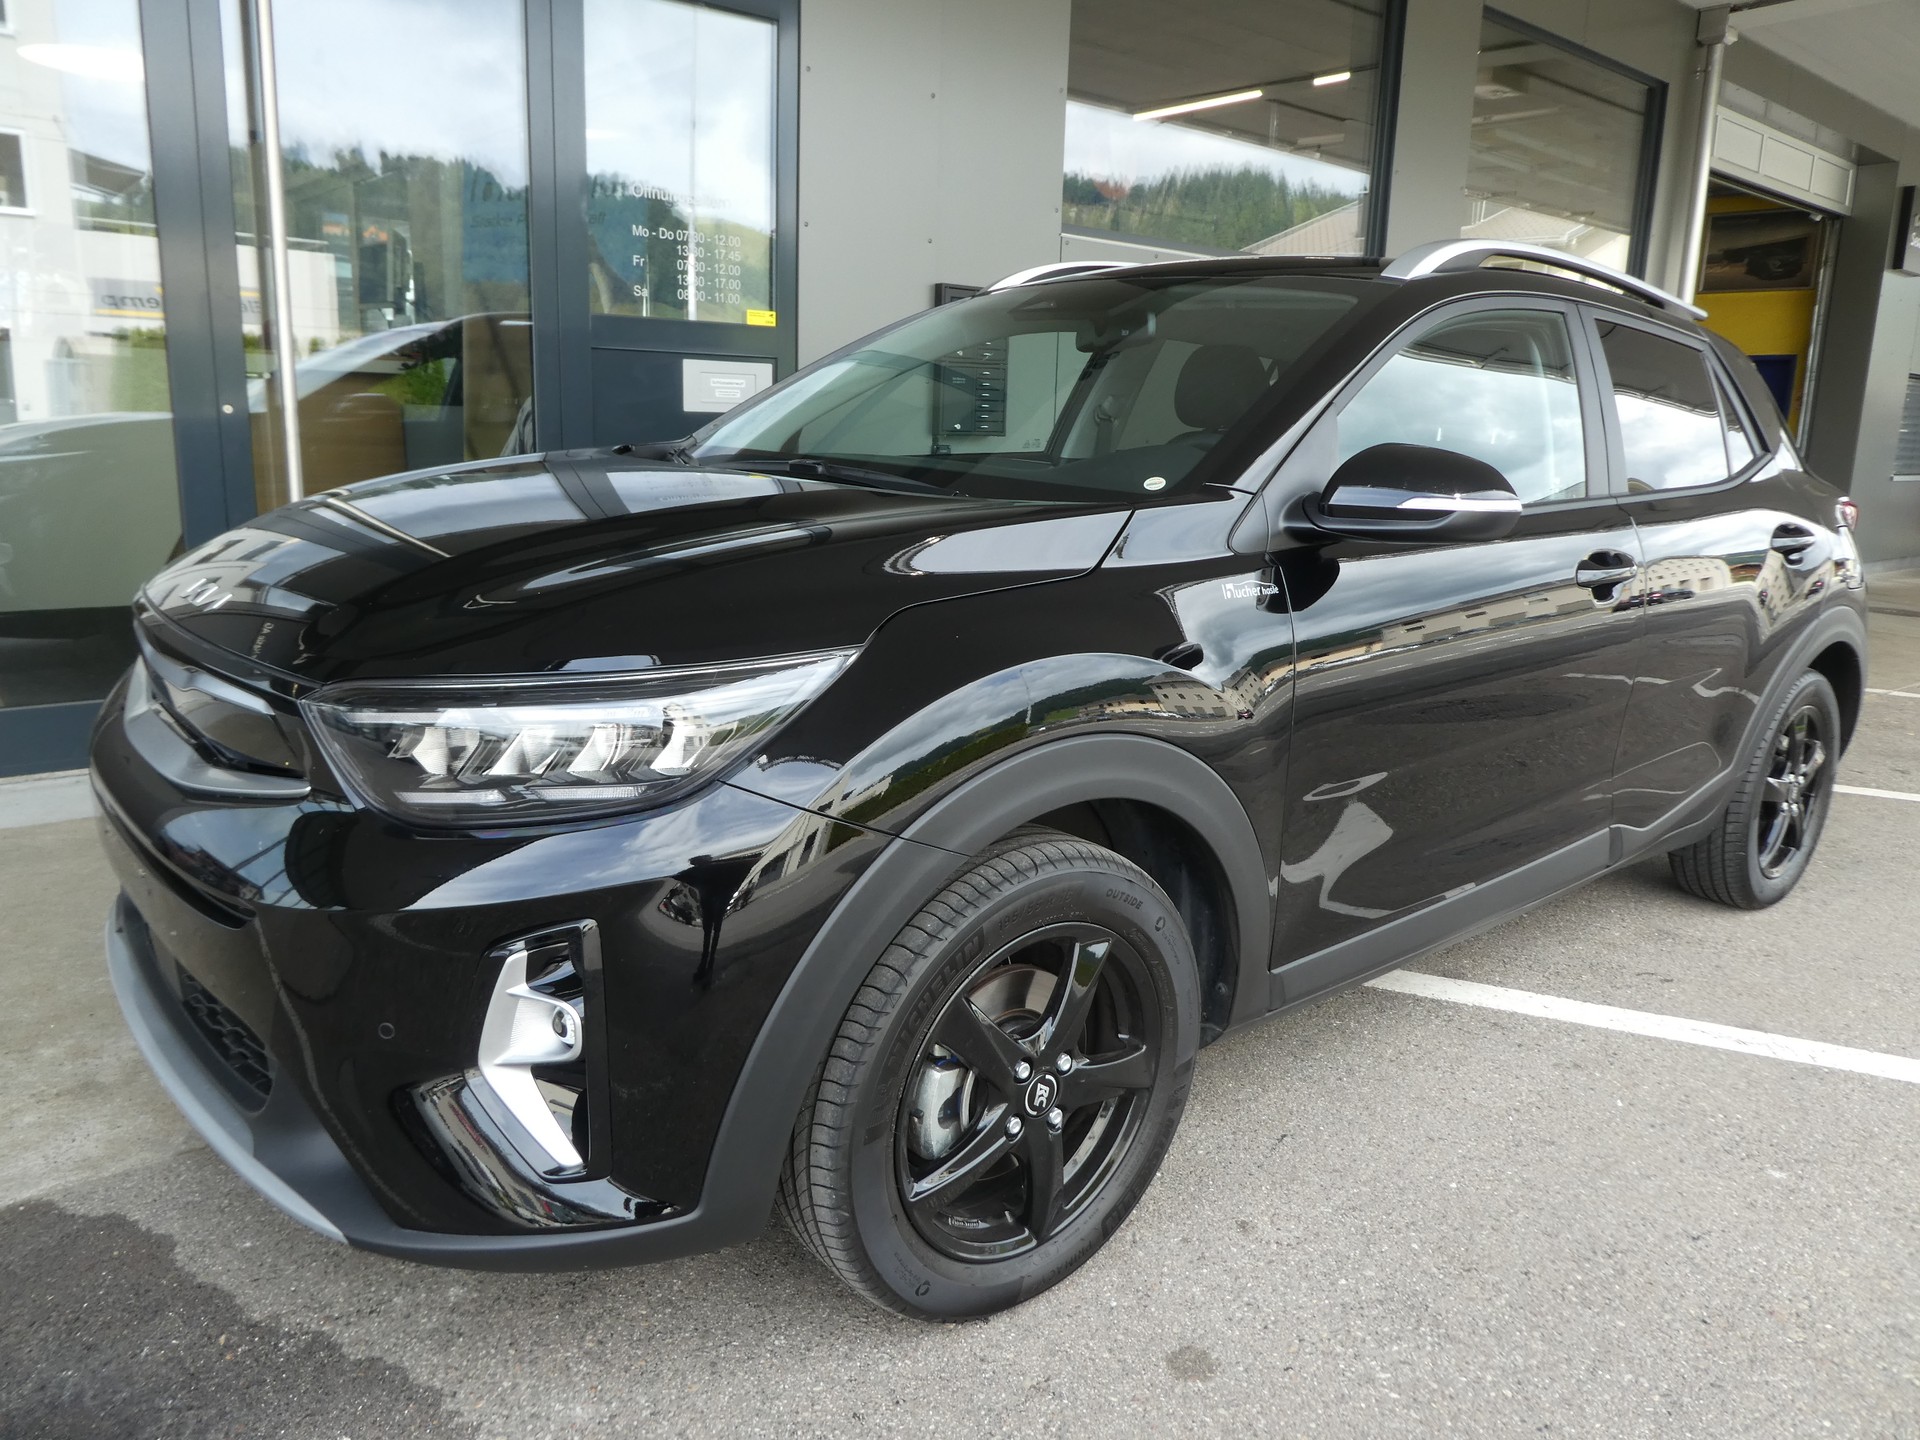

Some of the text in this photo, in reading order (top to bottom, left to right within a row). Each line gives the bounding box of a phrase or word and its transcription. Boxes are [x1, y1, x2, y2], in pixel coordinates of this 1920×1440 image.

[632, 225, 650, 237] Mo
[659, 228, 674, 240] Do
[677, 230, 704, 244] 0730
[715, 234, 741, 247] 12.00
[677, 245, 704, 258] 1330
[715, 249, 741, 262] 17.45
[633, 255, 644, 266] Fr
[677, 260, 705, 273] 0730
[715, 263, 741, 276] 12.00
[677, 275, 704, 287] 1330
[715, 278, 741, 290] 17.00
[633, 285, 648, 297] Sa
[715, 292, 740, 305] 11.00
[1105, 887, 1144, 910] OUTSIDE
